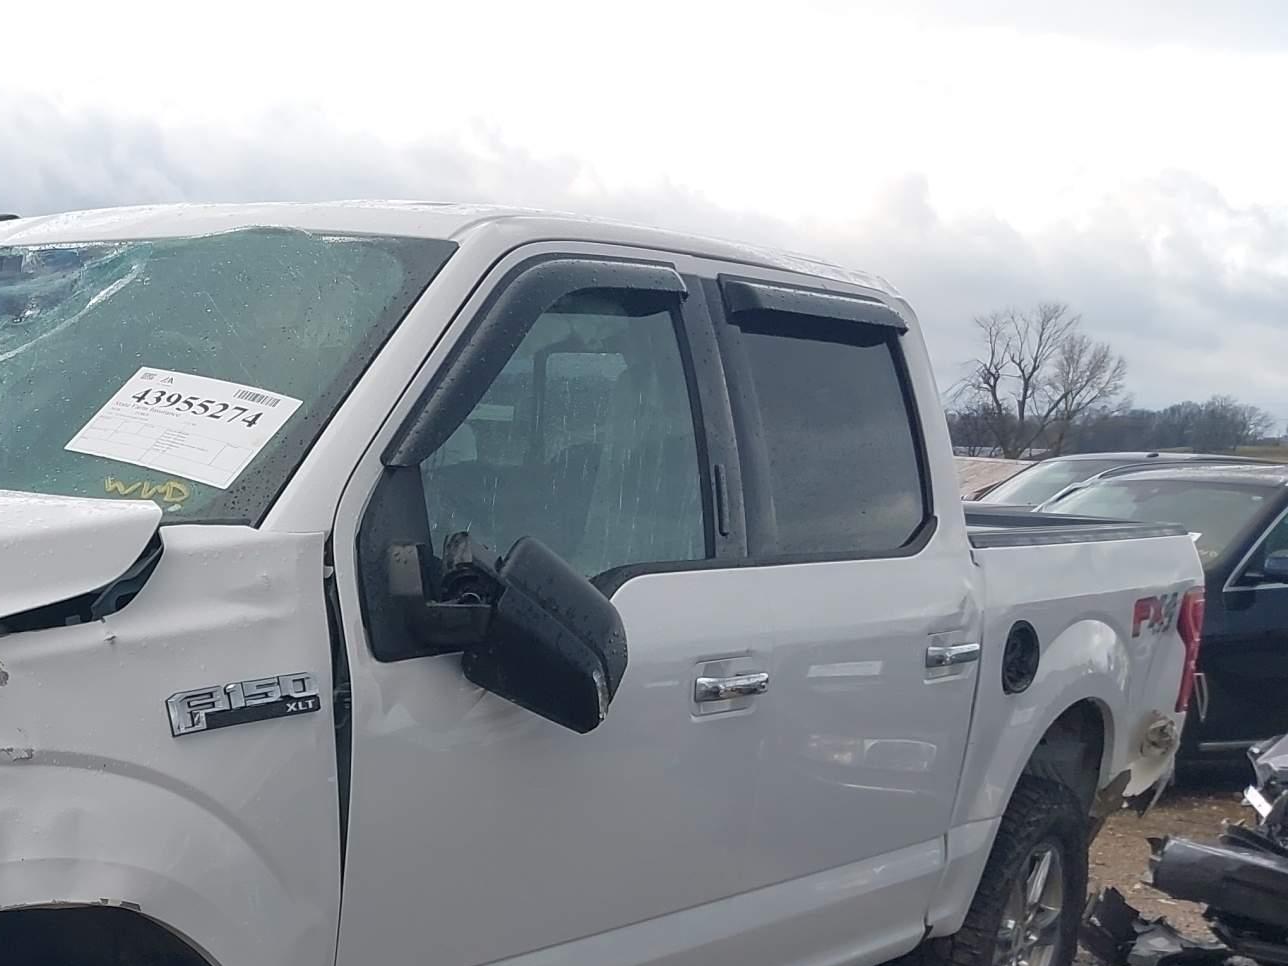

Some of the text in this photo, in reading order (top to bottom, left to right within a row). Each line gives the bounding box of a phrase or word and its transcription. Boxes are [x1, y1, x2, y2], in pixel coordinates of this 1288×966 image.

[132, 388, 264, 428] 43955274
[165, 672, 320, 736] F150
[285, 698, 315, 713] XLT
